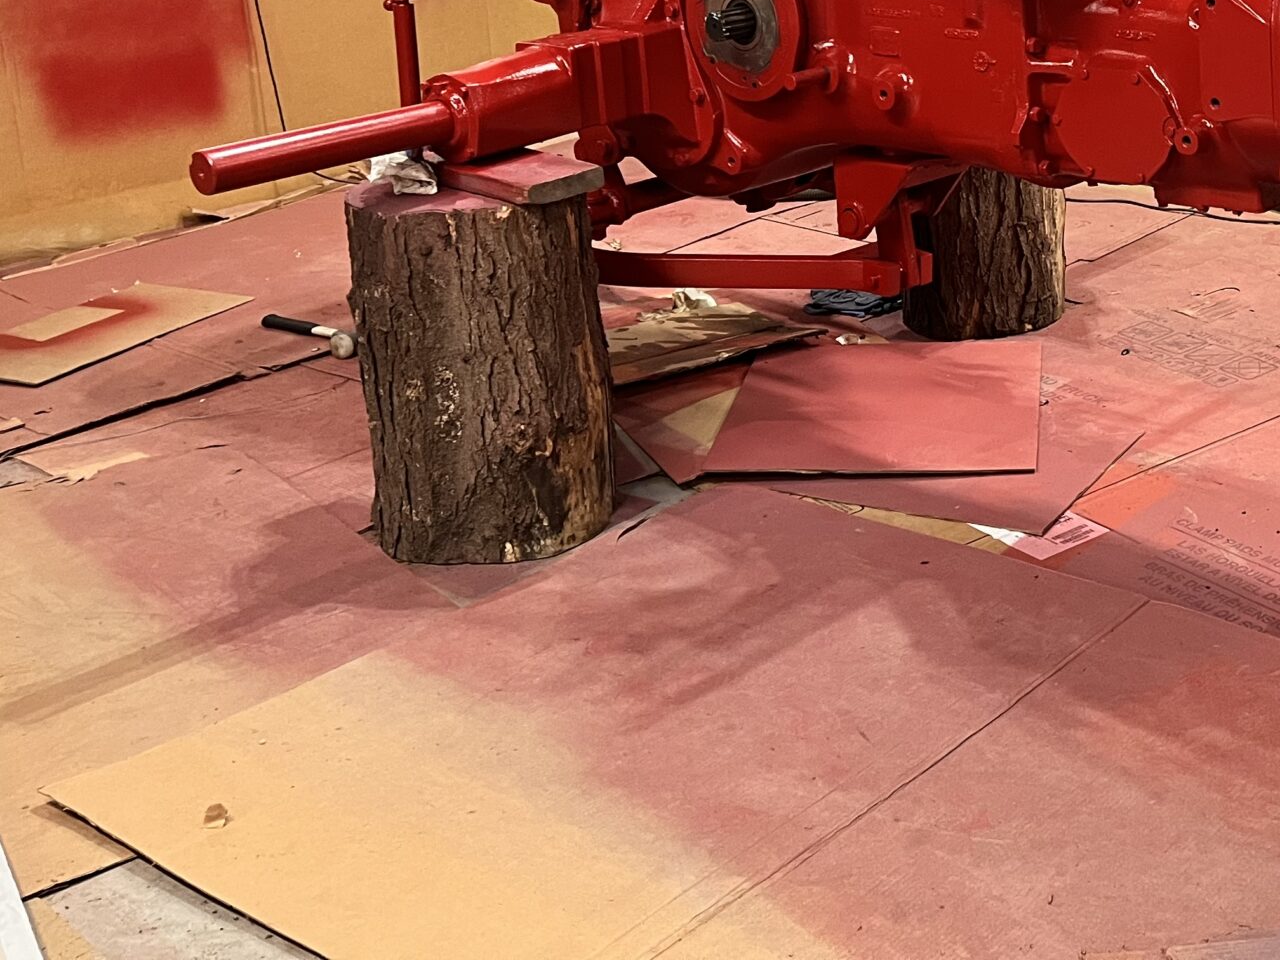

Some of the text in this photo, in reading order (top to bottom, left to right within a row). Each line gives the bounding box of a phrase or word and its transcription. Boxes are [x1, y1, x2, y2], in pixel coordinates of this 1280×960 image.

[1176, 519, 1224, 541] CLAMP
[1223, 539, 1263, 558] PADS
[1176, 540, 1207, 556] LAS
[1144, 562, 1186, 583] BRAS
[1183, 579, 1206, 592] DE
[1164, 548, 1210, 570] ESTAR
[1207, 568, 1222, 578] A
[1222, 572, 1262, 596] NIVEL
[1138, 575, 1165, 587] AU
[1162, 583, 1218, 613] NIVEAU
